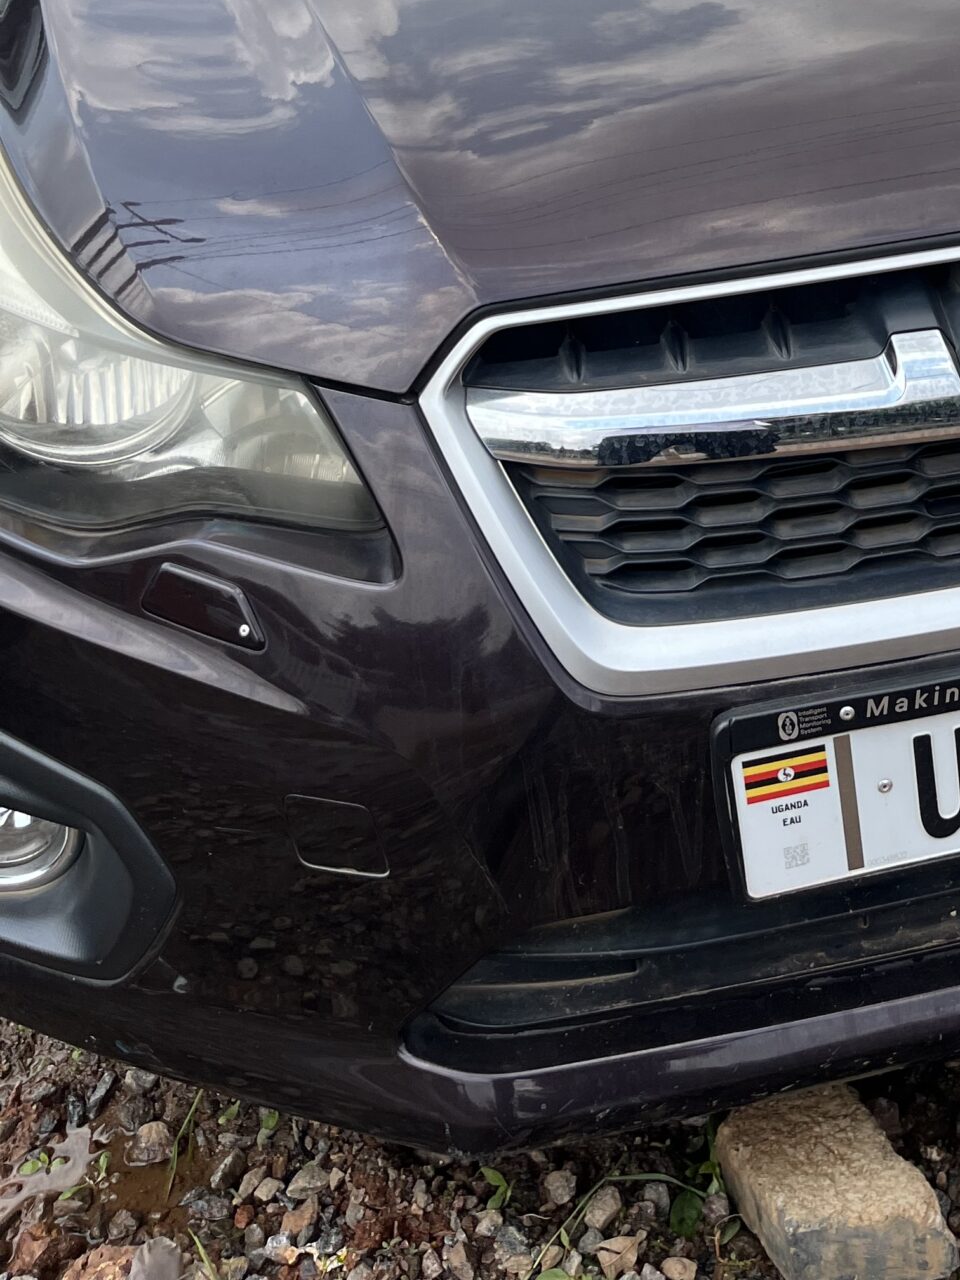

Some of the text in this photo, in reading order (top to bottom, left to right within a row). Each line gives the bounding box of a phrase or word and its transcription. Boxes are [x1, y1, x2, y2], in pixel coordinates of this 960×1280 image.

[799, 713, 828, 723] Transport
[800, 719, 832, 729] Monitoring
[771, 799, 809, 814] UGANDA
[782, 815, 801, 827] EAU
